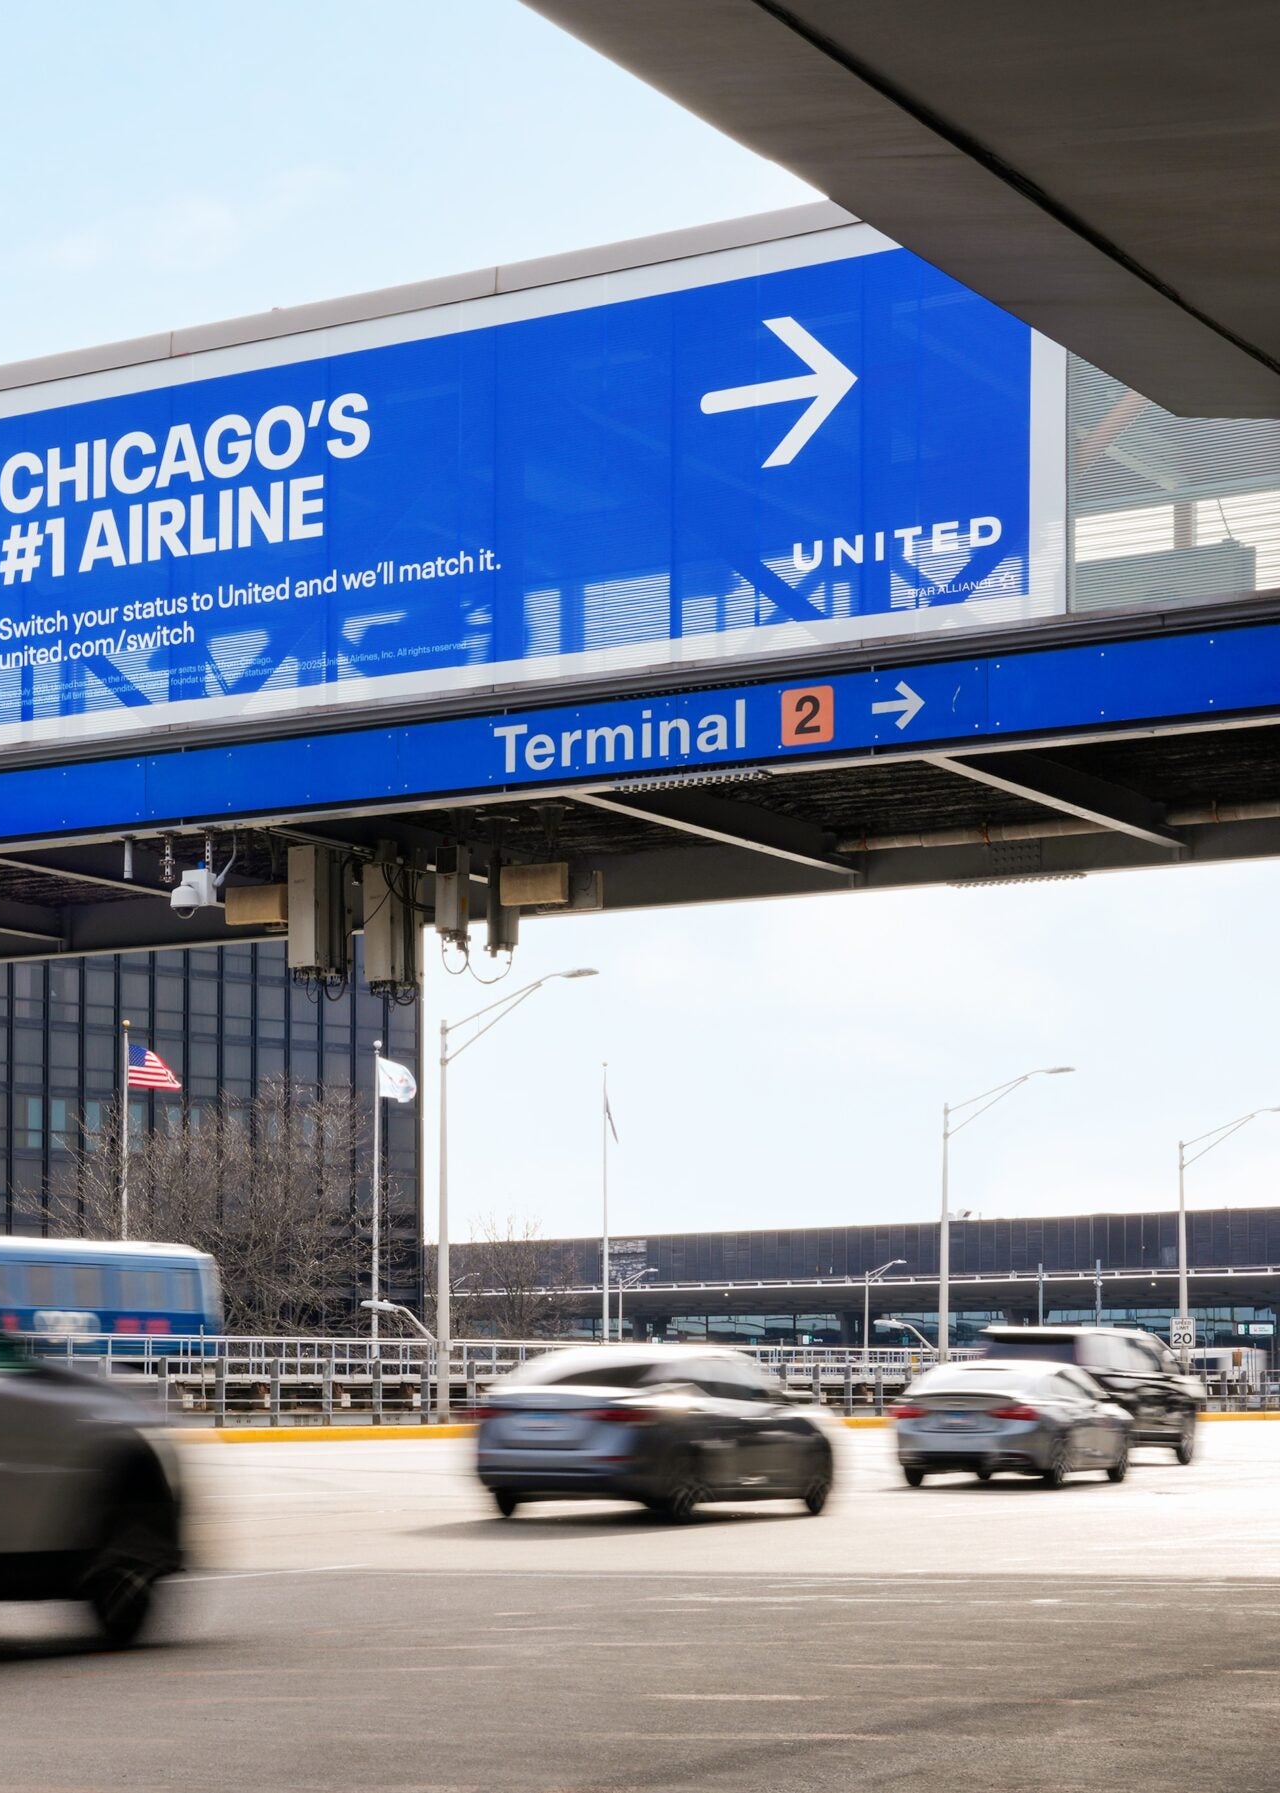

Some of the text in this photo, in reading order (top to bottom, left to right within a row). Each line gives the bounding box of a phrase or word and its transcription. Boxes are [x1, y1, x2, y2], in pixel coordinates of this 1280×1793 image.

[78, 474, 324, 573] AIRLINE
[792, 515, 1002, 571] UNITED
[72, 606, 120, 634] your
[122, 595, 188, 622] status
[191, 592, 214, 612] to
[218, 576, 290, 608] United
[294, 569, 338, 599] and
[399, 550, 474, 583] match
[479, 548, 502, 571] it.
[197, 663, 205, 672] to
[381, 648, 396, 659] Inc.
[397, 646, 408, 657] All
[408, 644, 431, 657] rights
[493, 695, 821, 774] Terminal 2
[1173, 1333, 1192, 1344] 20
